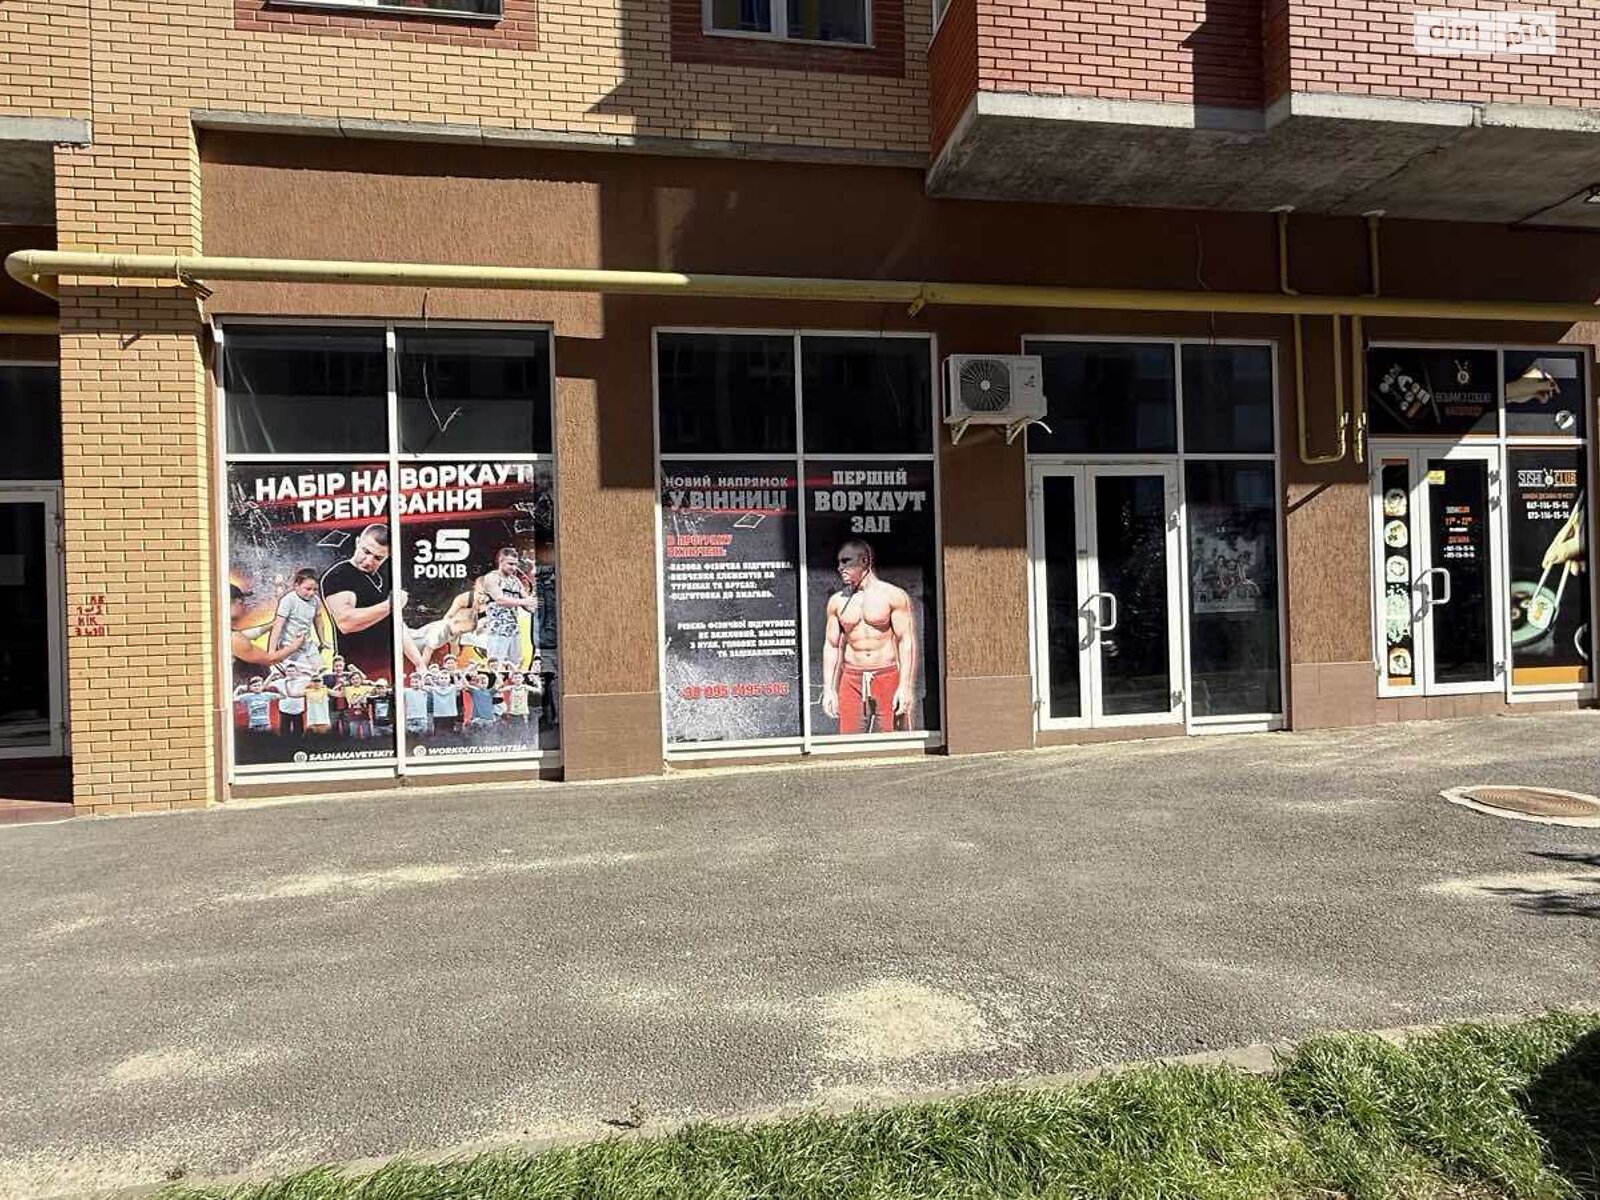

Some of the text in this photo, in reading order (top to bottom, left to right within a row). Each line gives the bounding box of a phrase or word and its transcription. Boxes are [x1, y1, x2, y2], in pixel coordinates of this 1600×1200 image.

[255, 472, 345, 501] НАБІР
[351, 469, 390, 495] НА
[665, 474, 788, 489] НОВИЙ НАПРЯМОК
[832, 467, 908, 486] ПЕРШИЙ
[1554, 471, 1577, 485] CLUB
[297, 488, 483, 523] ТРЕНУВАННЯ
[668, 490, 788, 512] У ВІННИЦІ
[813, 490, 927, 512] ВОРКАУТ
[850, 515, 891, 533] ЗАЛ
[413, 563, 468, 579] РОКІВ
